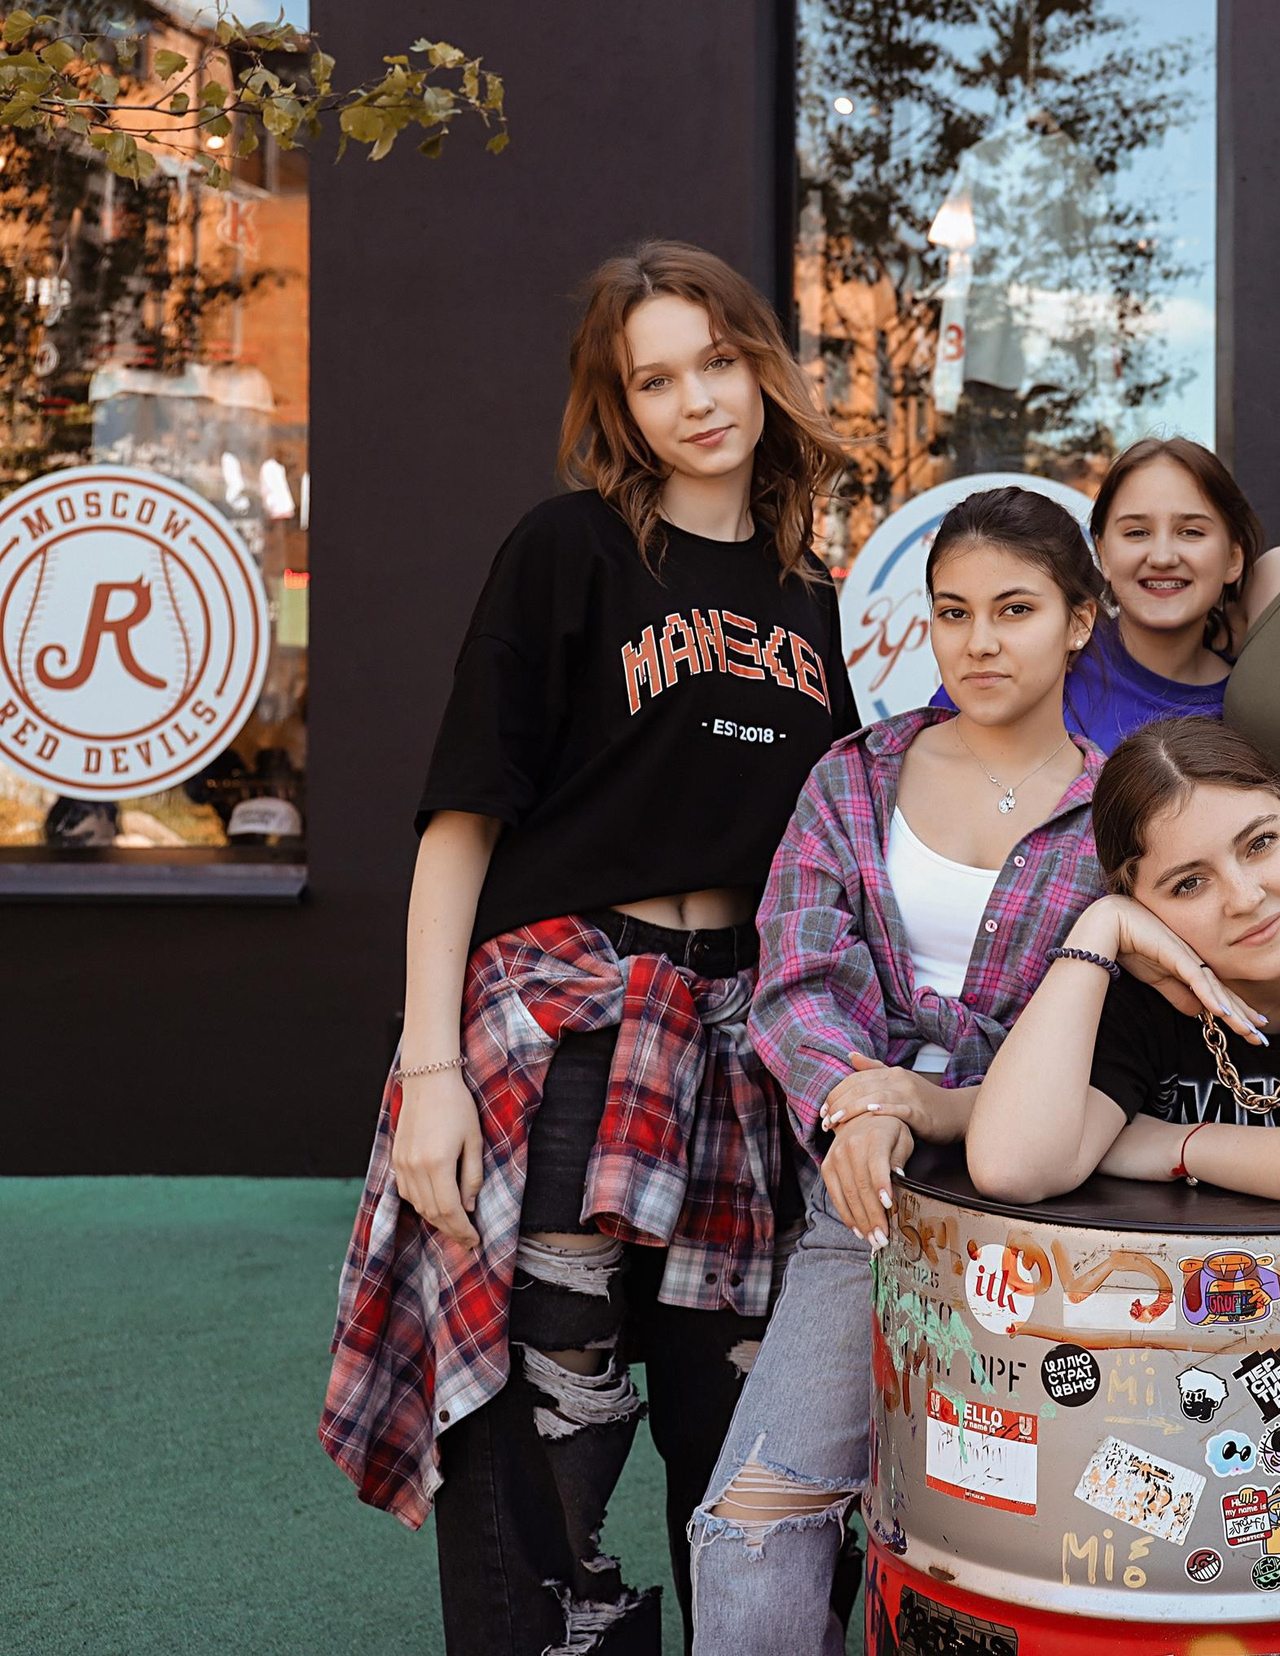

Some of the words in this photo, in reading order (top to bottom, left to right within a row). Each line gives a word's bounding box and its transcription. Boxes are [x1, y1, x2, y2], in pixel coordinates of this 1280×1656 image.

[21, 491, 191, 541] MOSCOW
[0, 699, 59, 760] RED
[84, 700, 218, 774] DEVILS
[739, 725, 774, 743] 2018
[1209, 1294, 1239, 1313] GRUF
[1045, 1353, 1091, 1373] ИЛЛЮ
[1240, 1357, 1275, 1387] ПЕР
[1048, 1365, 1093, 1385] СТРАТ
[1051, 1377, 1097, 1398] ИВНО
[969, 1421, 987, 1432] name
[1225, 1509, 1236, 1517] my
[1238, 1505, 1259, 1514] name
[1260, 1503, 1266, 1511] is
